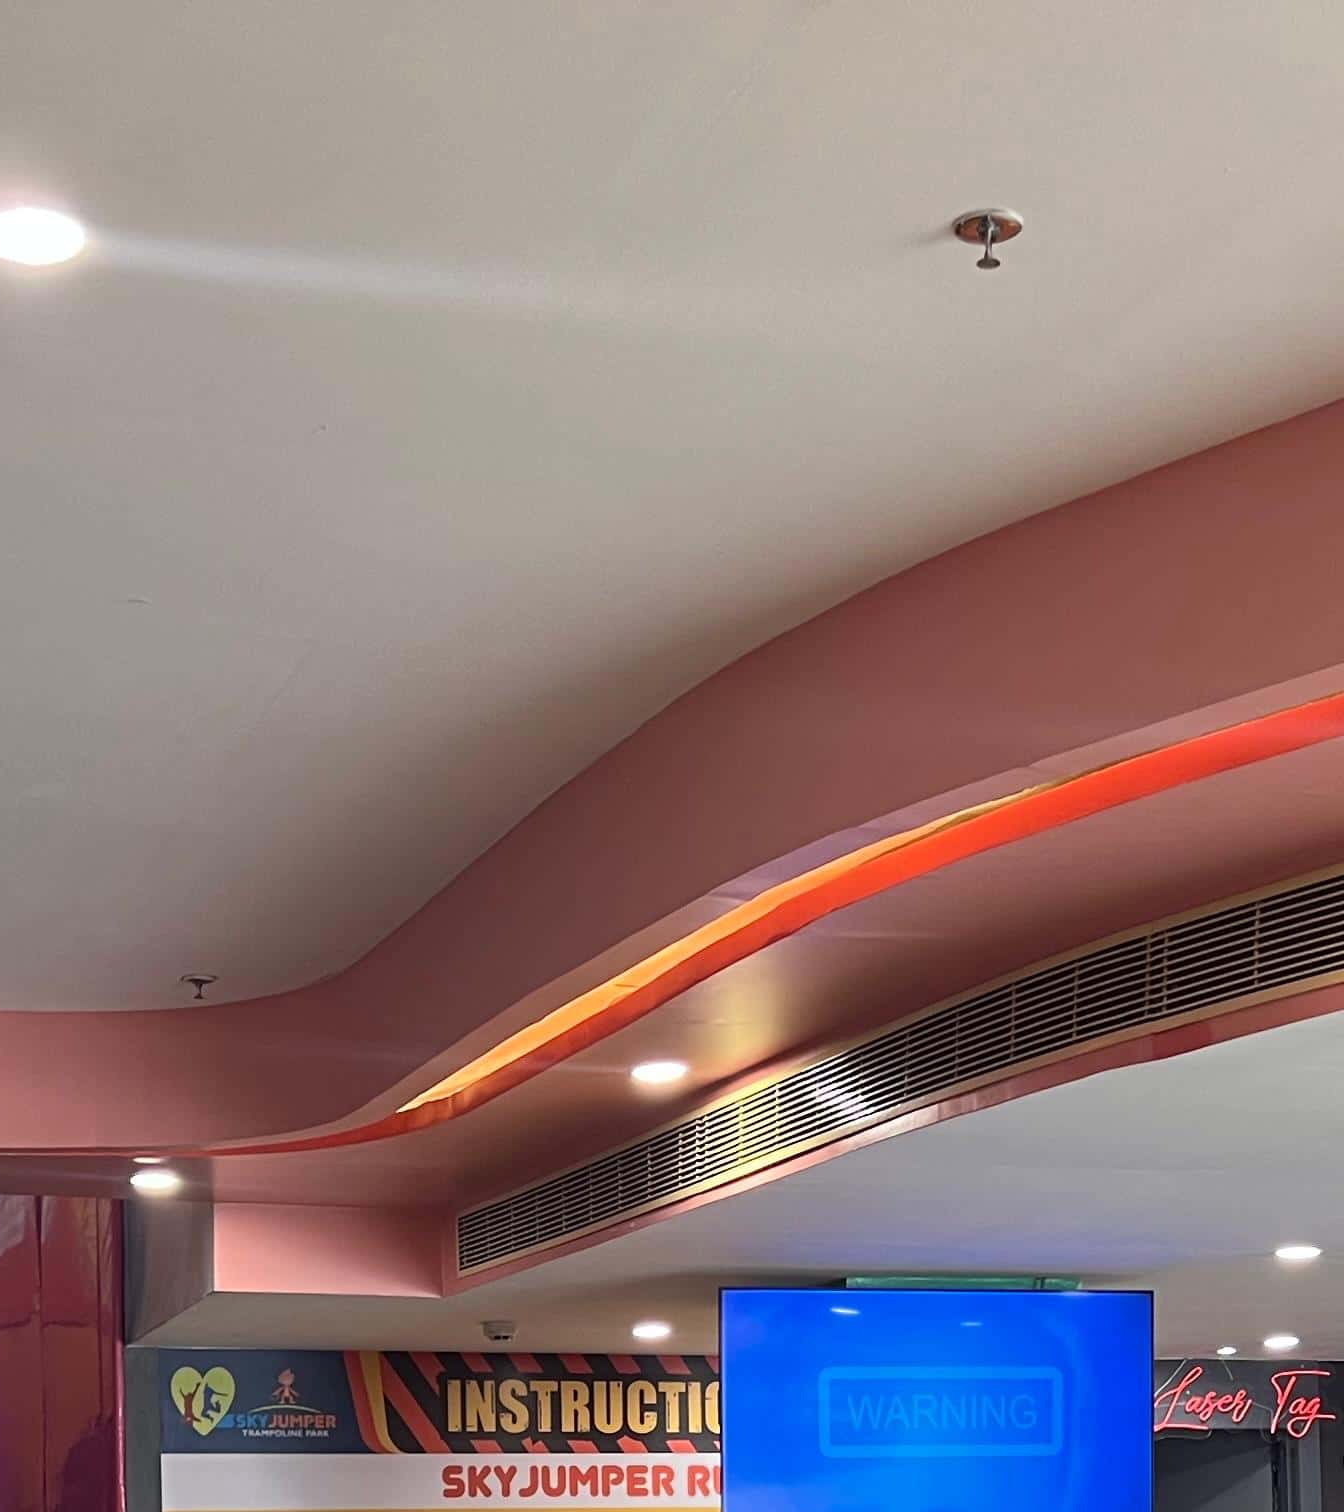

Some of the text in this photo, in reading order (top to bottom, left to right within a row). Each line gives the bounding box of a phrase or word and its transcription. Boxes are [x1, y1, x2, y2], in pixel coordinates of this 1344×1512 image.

[847, 1393, 1038, 1430] WARNING
[1154, 1366, 1337, 1437] Laser Tag
[242, 1429, 303, 1437] TRAMPOLINE
